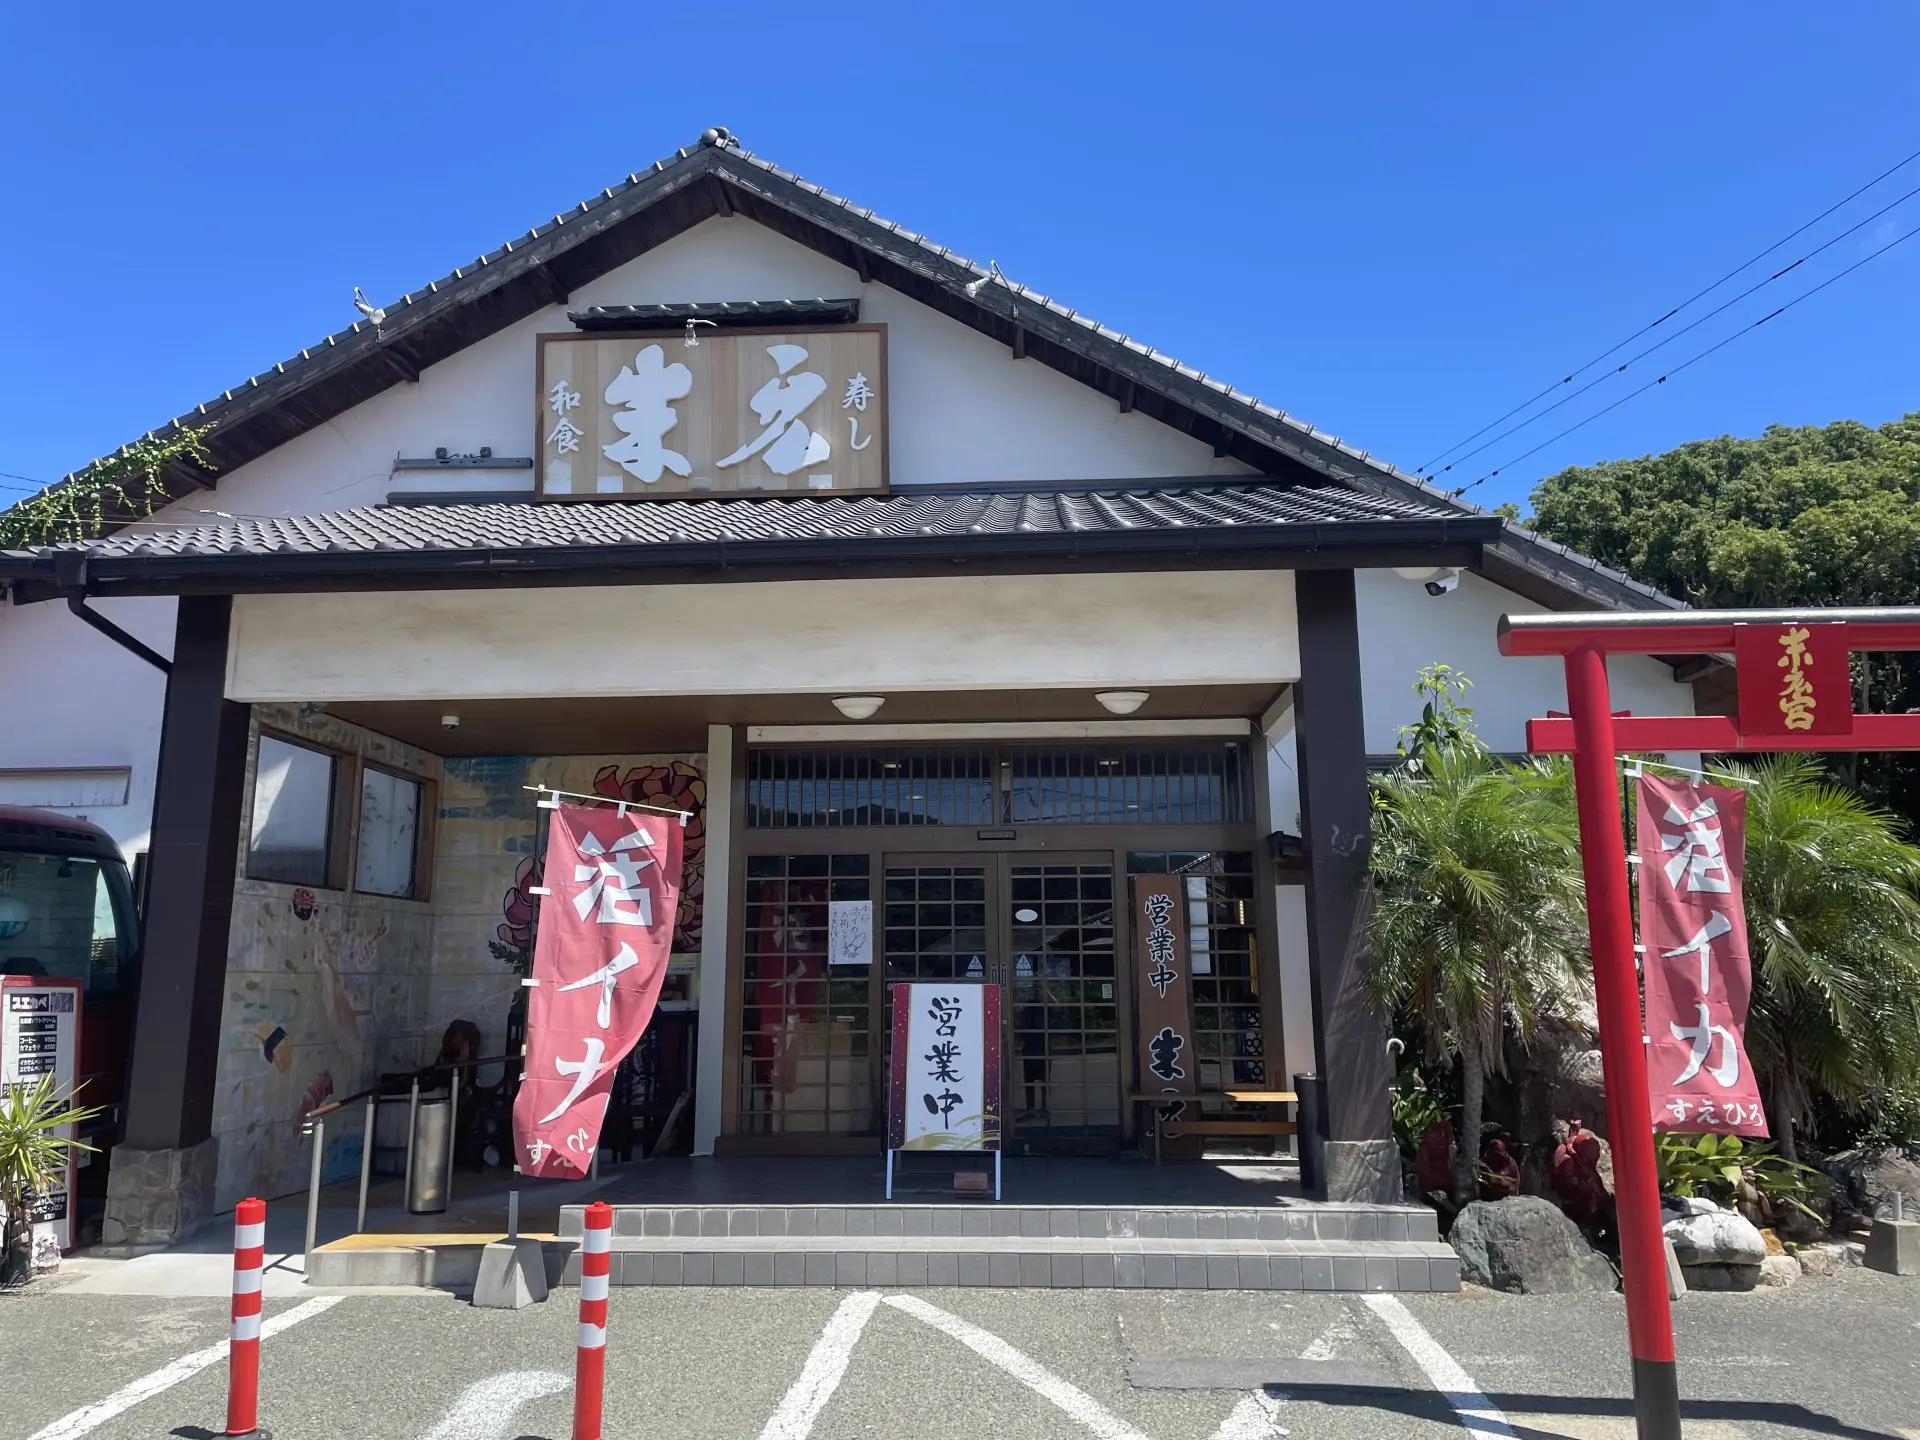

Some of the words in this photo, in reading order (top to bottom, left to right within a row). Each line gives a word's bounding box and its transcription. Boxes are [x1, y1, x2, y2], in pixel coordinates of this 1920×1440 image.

[546, 379, 585, 455] 和食
[842, 371, 875, 451] 寿し
[1144, 894, 1178, 999] 営業中
[923, 996, 965, 1130] 営業中
[1665, 1098, 1764, 1127] すえひろ
